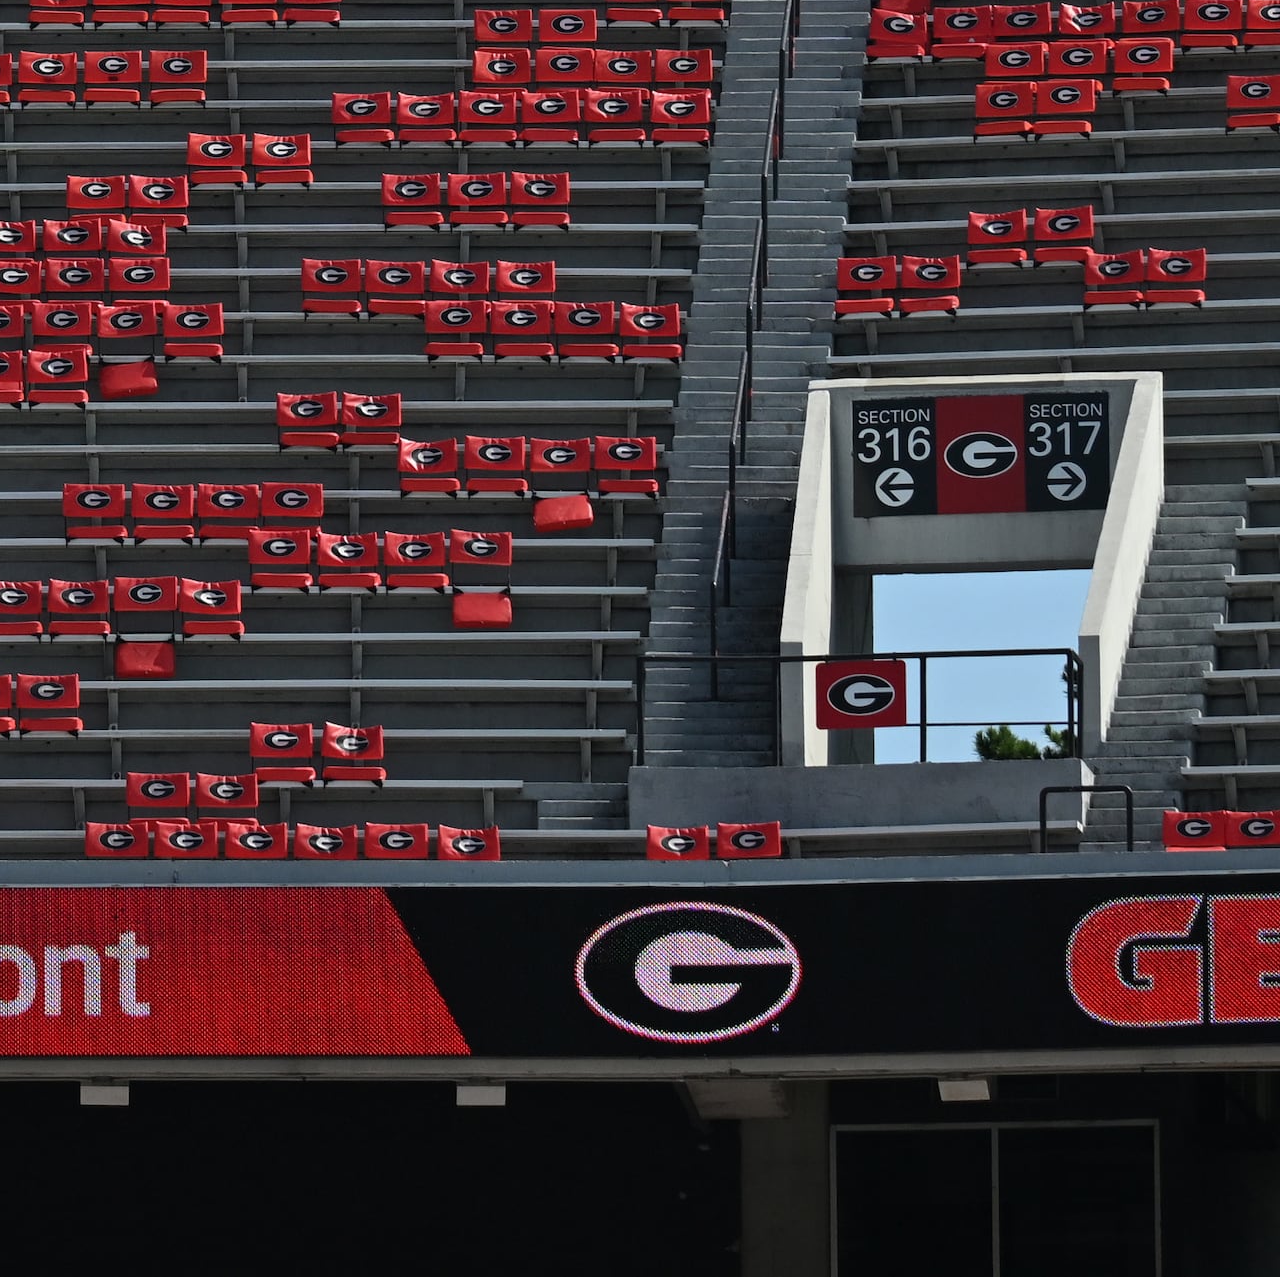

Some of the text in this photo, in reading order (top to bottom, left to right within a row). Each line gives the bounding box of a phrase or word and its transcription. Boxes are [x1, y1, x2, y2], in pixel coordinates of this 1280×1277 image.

[857, 408, 931, 425] SECTION
[1029, 402, 1103, 418] SECTION
[857, 426, 932, 464] 316
[1028, 421, 1102, 458] 317
